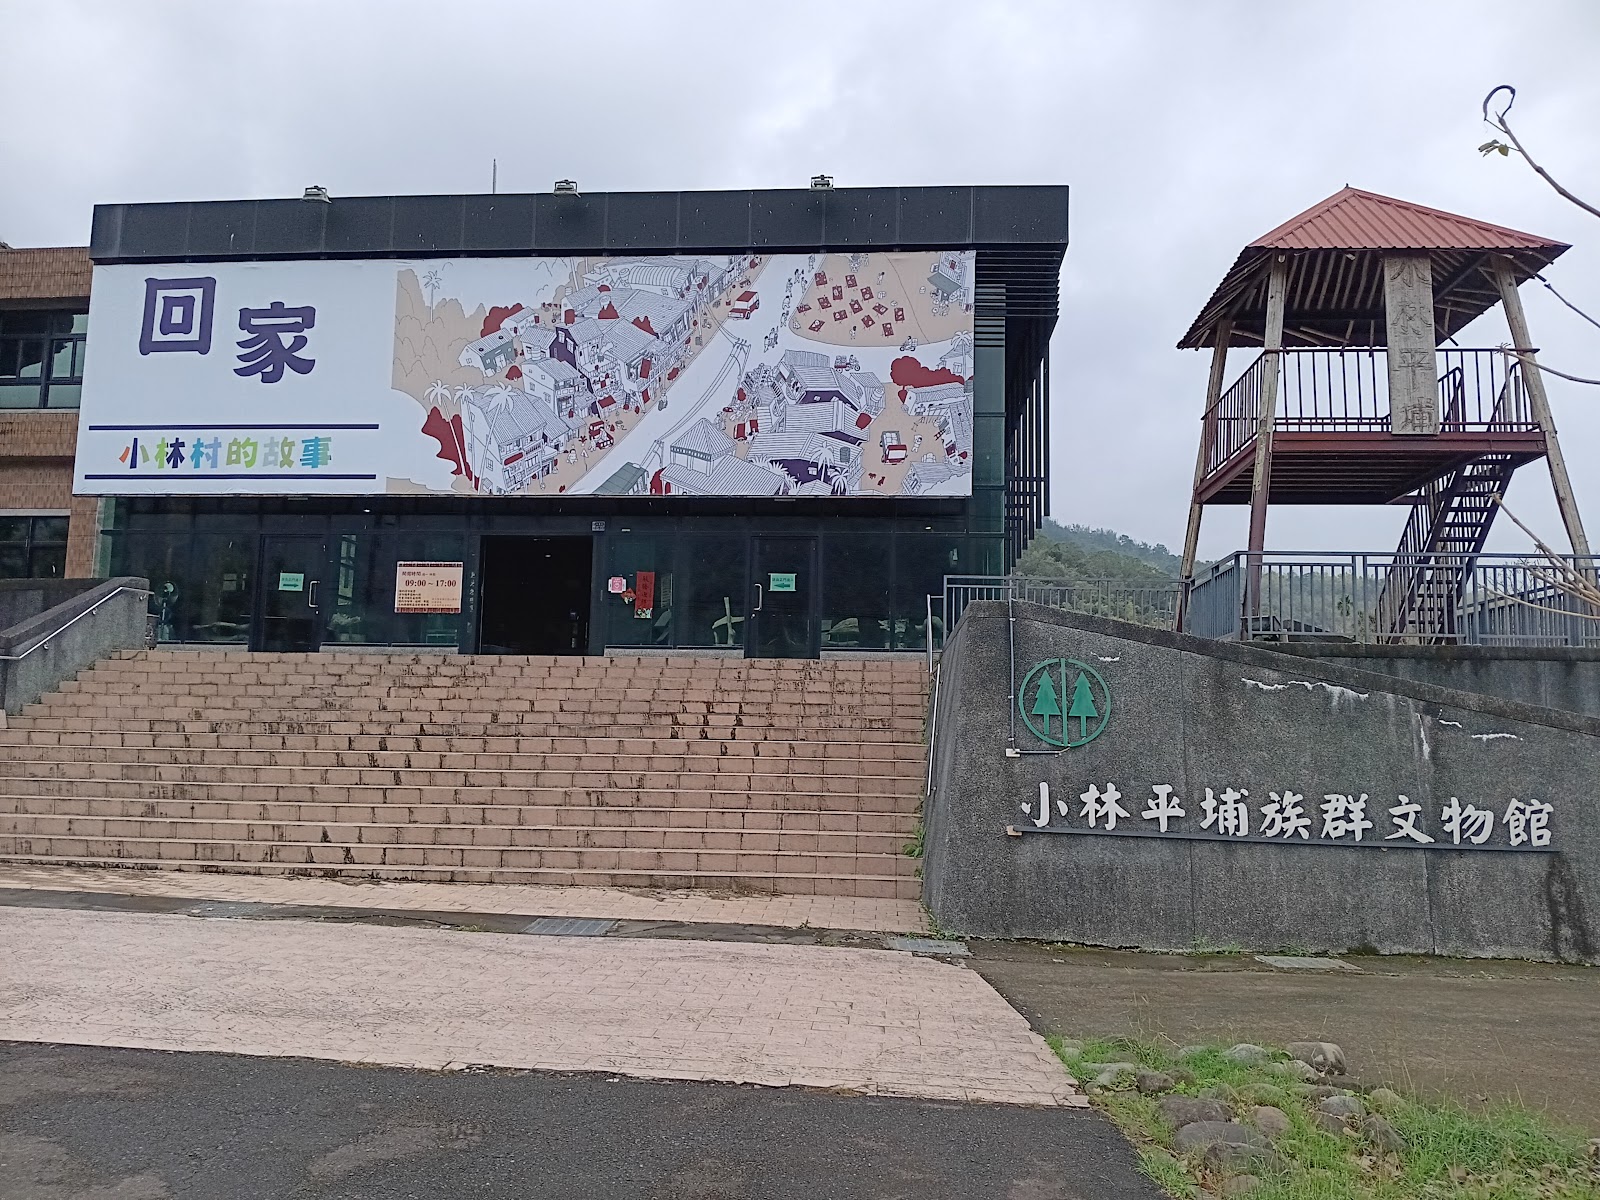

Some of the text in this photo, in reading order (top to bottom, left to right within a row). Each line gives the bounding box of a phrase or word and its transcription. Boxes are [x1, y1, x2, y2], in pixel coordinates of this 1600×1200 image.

[138, 276, 317, 383] 回家
[118, 436, 333, 470] 小林村的故事
[405, 579, 427, 587] 09:00
[435, 579, 457, 587] 17:00
[1021, 781, 1555, 847] 小林平埔族群文物館
